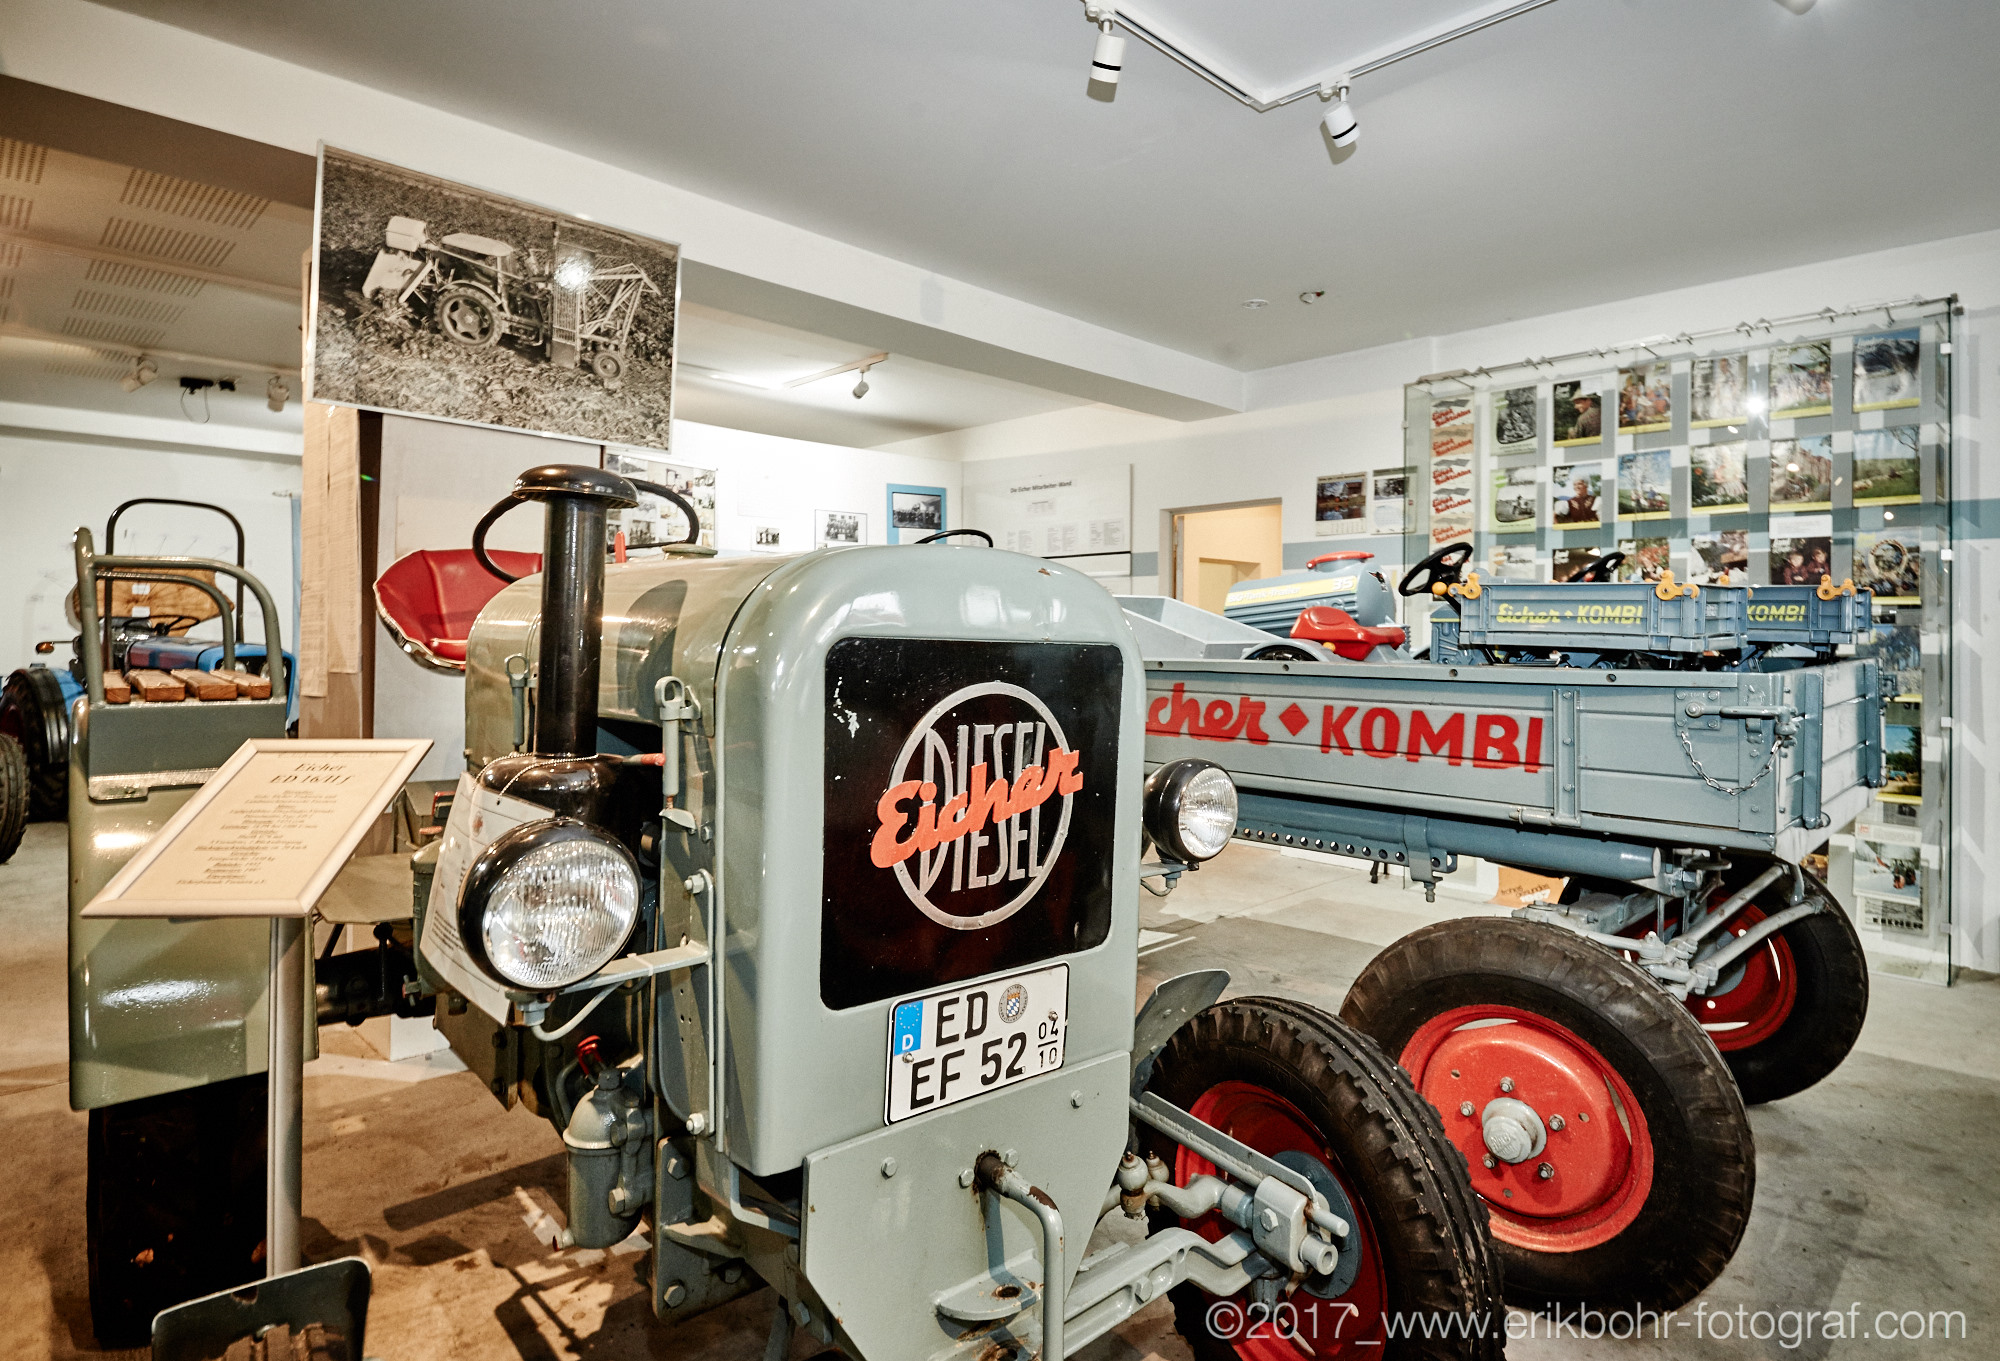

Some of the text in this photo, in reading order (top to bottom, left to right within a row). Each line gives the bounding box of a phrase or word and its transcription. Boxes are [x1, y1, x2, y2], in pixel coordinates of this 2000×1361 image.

[1496, 603, 1643, 625] Eicher KOMBI
[1146, 682, 1543, 774] cher KOMBI
[870, 747, 1083, 868] Eicher
[918, 721, 1047, 898] DIESEL
[902, 1034, 914, 1050] D
[935, 990, 989, 1048] ED
[910, 1031, 1027, 1111] EF 52
[1038, 1047, 1058, 1069] 10
